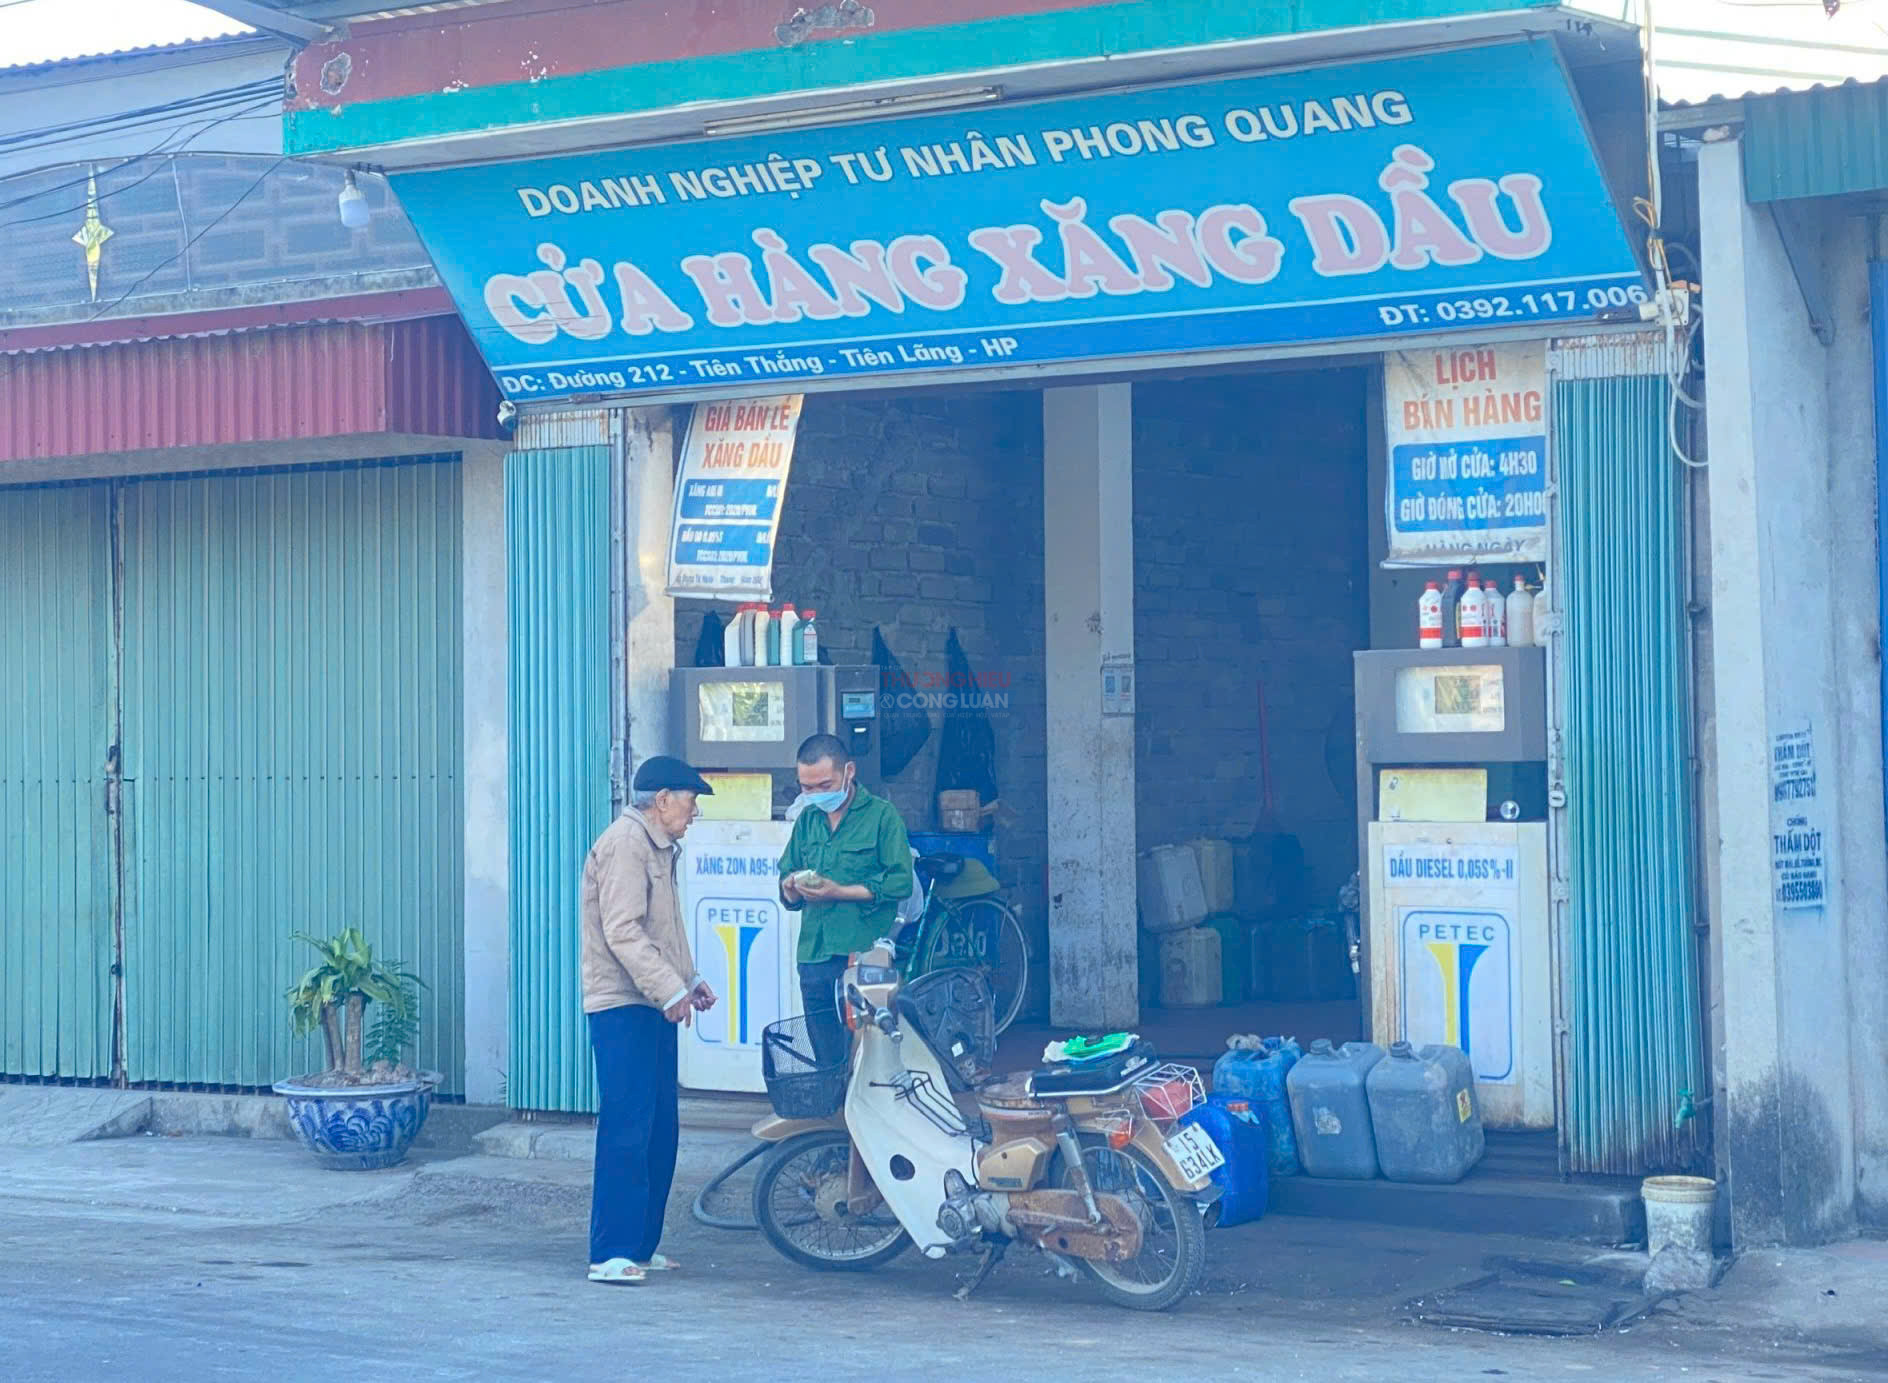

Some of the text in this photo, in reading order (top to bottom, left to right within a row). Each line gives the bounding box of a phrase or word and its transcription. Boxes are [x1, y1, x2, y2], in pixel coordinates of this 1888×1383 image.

[517, 89, 1413, 218] DOANH NGHIỆP TƯ NHÂN PHONG QUANG
[483, 142, 1552, 345] CỬA HÀNG XĂNG DẦU
[1378, 285, 1649, 327] ĐT: 0392.117.006
[501, 374, 545, 394] ĐC:
[547, 368, 627, 390] Đường
[628, 363, 674, 385] 212
[689, 358, 743, 379] Tiên
[743, 349, 824, 375] Thắng
[839, 346, 895, 368] Tiên
[896, 342, 964, 364] Lãng
[980, 336, 1019, 358] HP
[1435, 349, 1497, 390] LỊCH
[704, 401, 733, 432] GIÁ
[734, 400, 770, 432] BÁN
[1463, 388, 1542, 426] HÀNG
[702, 437, 745, 469] XĂNG
[1411, 451, 1437, 481] GIỜ
[1460, 446, 1496, 478] CỬA:
[1499, 450, 1538, 476] 4H30
[1400, 491, 1425, 522] GIỜ
[1428, 492, 1465, 520] ĐÓNG
[1466, 487, 1501, 518] CỬA:
[696, 853, 724, 876] XĂNG
[1416, 858, 1454, 879] DIESEL
[707, 907, 768, 925] PETEC
[1419, 924, 1495, 942] PETEC
[1178, 1132, 1199, 1153] 15
